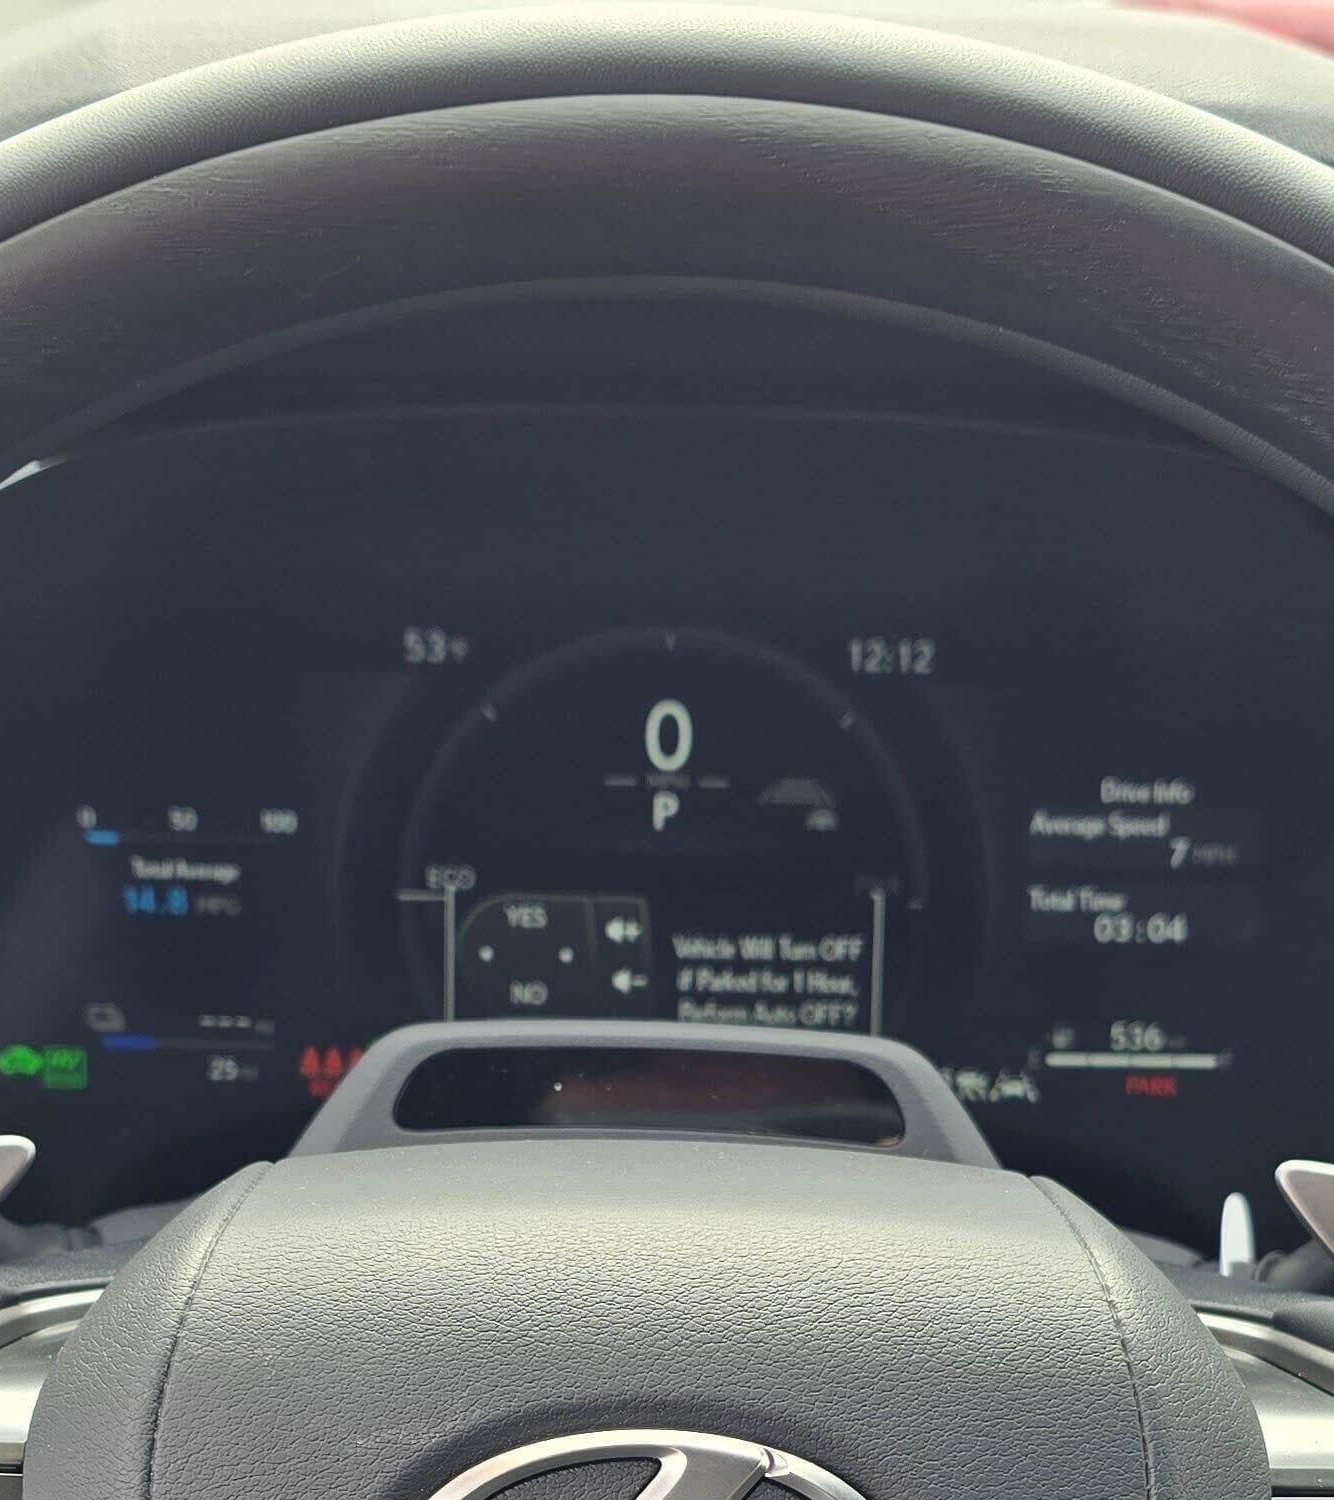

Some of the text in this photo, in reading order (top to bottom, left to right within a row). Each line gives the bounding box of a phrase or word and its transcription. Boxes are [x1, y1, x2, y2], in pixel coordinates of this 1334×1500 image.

[849, 639, 936, 675] 12:12
[644, 698, 693, 772] 0
[652, 791, 680, 832] P
[1029, 808, 1170, 839] Average Speed
[1027, 883, 1127, 912] Total Time
[504, 905, 547, 929] YES
[1093, 912, 1189, 944] 03:04
[671, 934, 736, 960] Vehicle
[777, 934, 817, 961] Turn
[818, 934, 864, 962] OFF
[508, 981, 549, 1006] NO
[1109, 1020, 1163, 1052] 536
